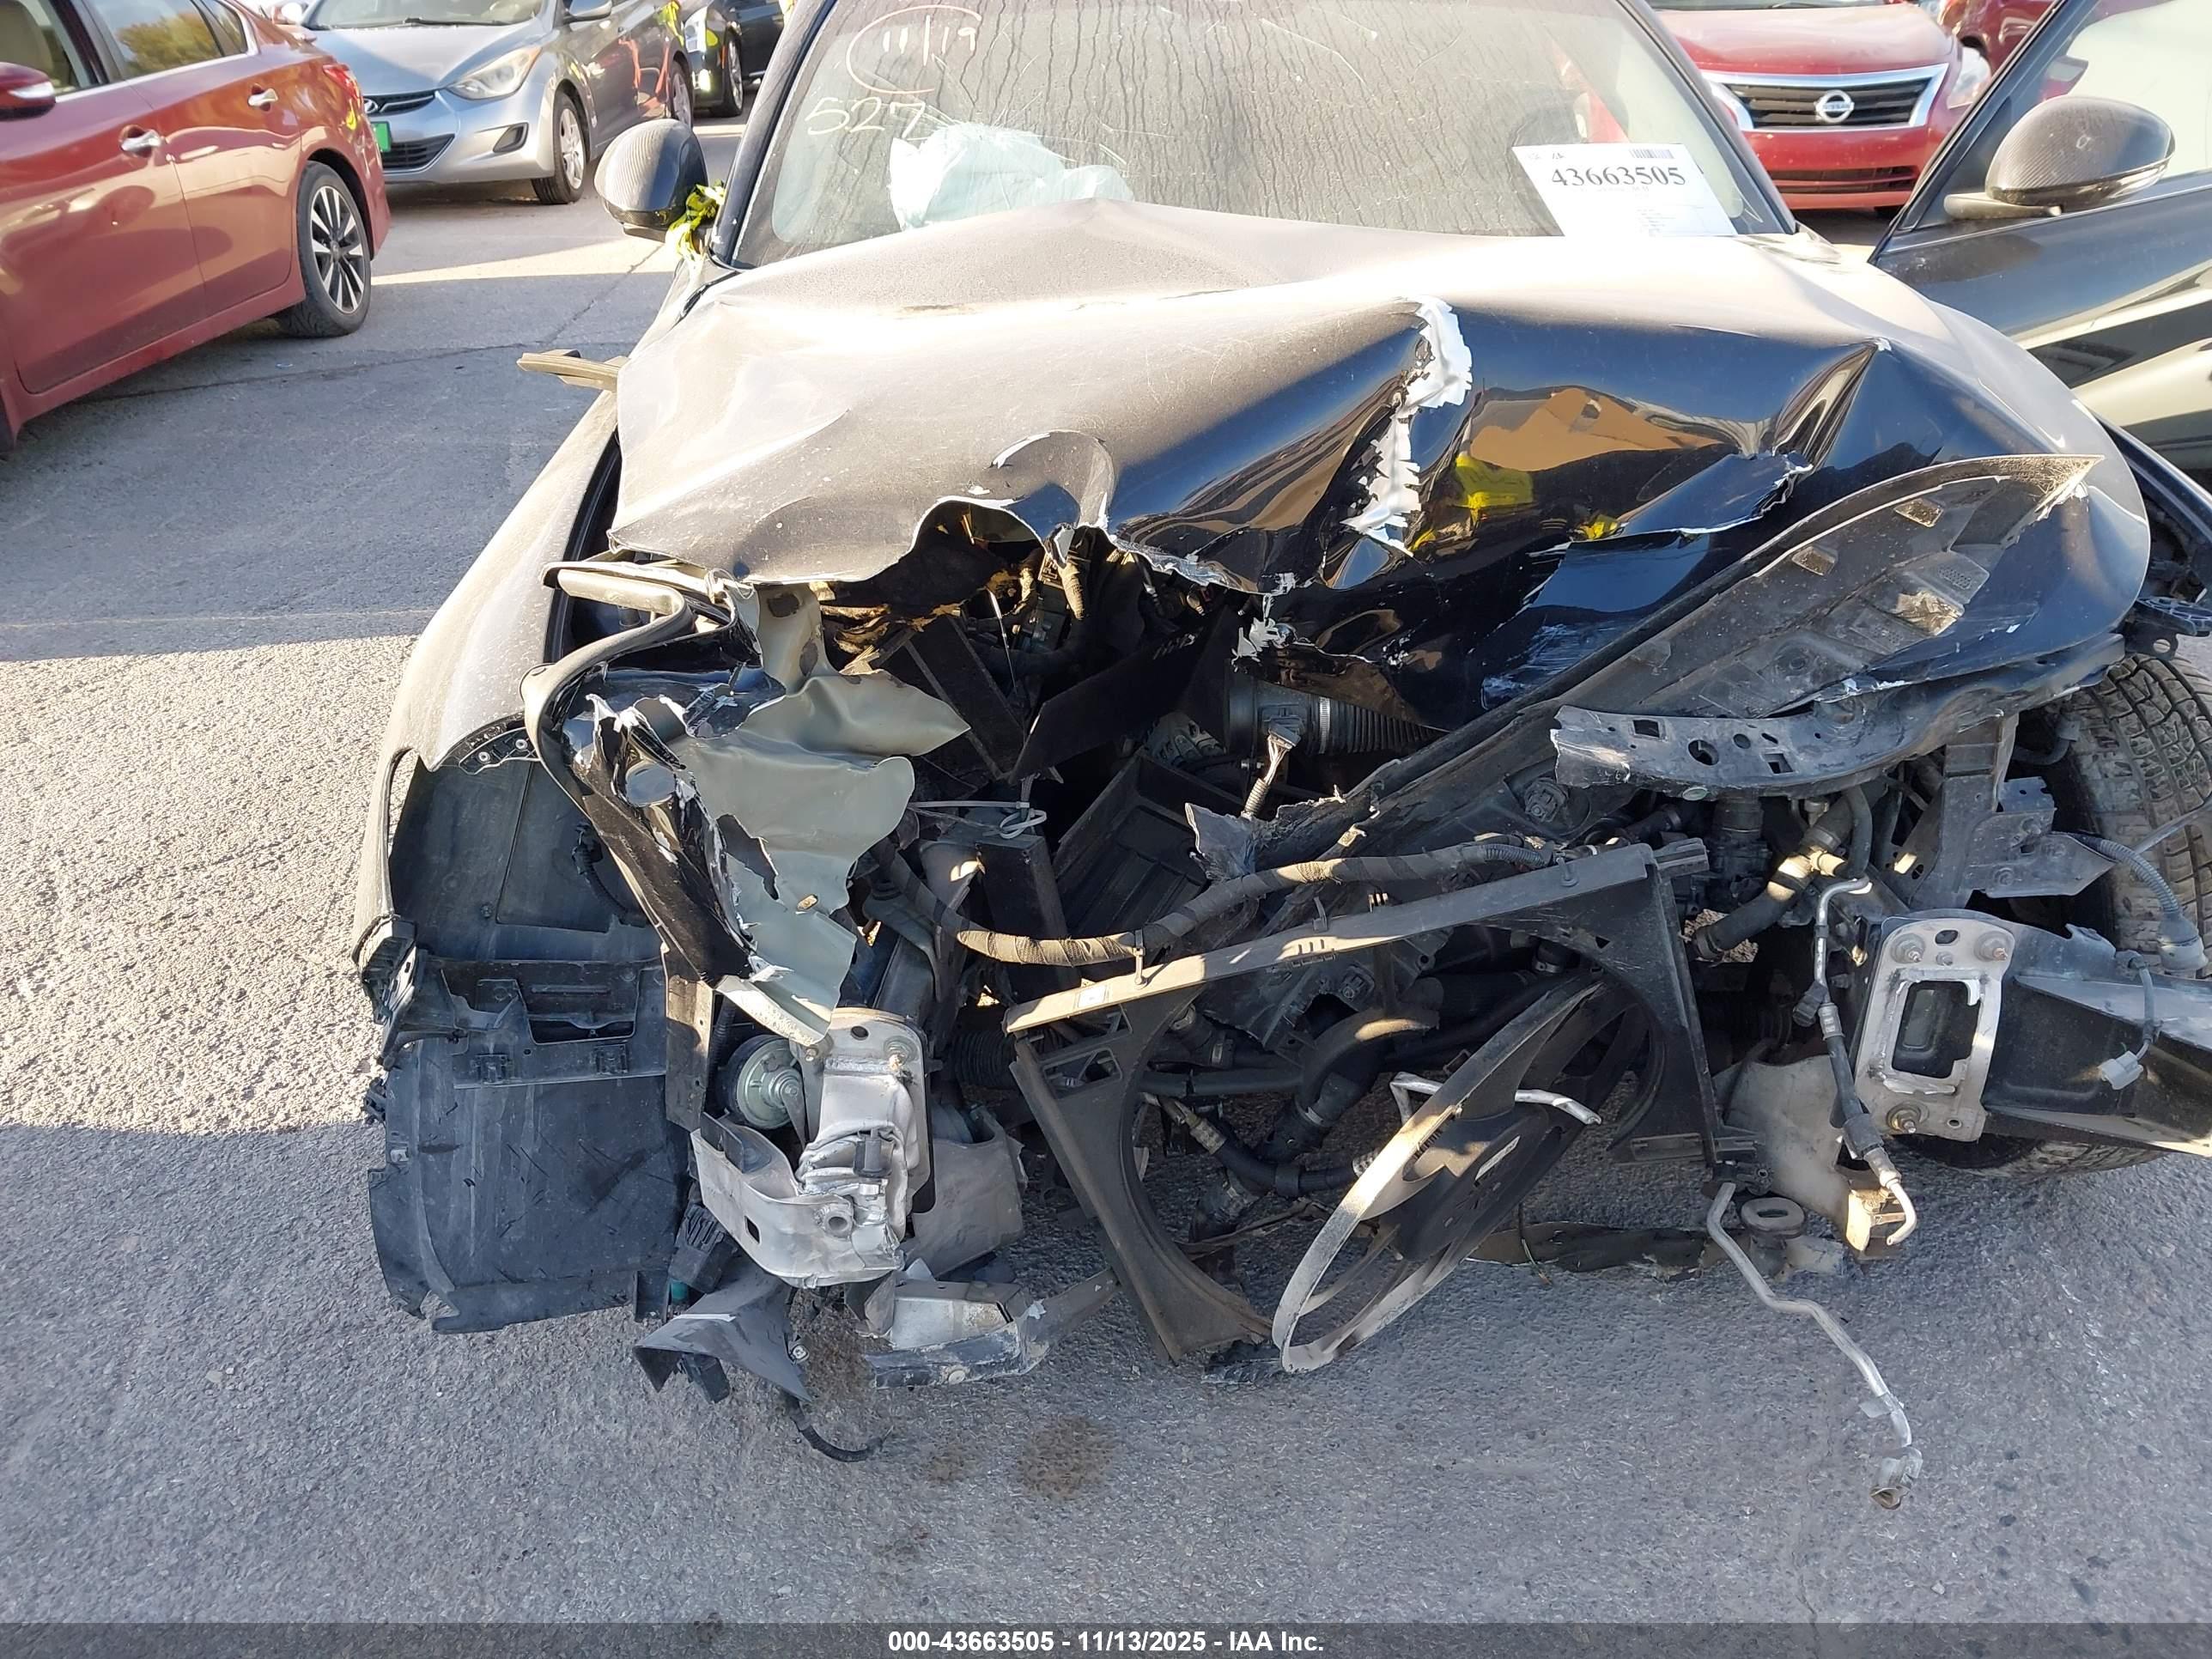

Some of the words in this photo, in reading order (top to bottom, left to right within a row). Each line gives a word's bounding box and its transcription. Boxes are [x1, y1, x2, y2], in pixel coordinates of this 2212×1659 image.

[883, 15, 976, 66] 11/19
[805, 96, 927, 139] 527
[1552, 166, 1686, 186] 43663505
